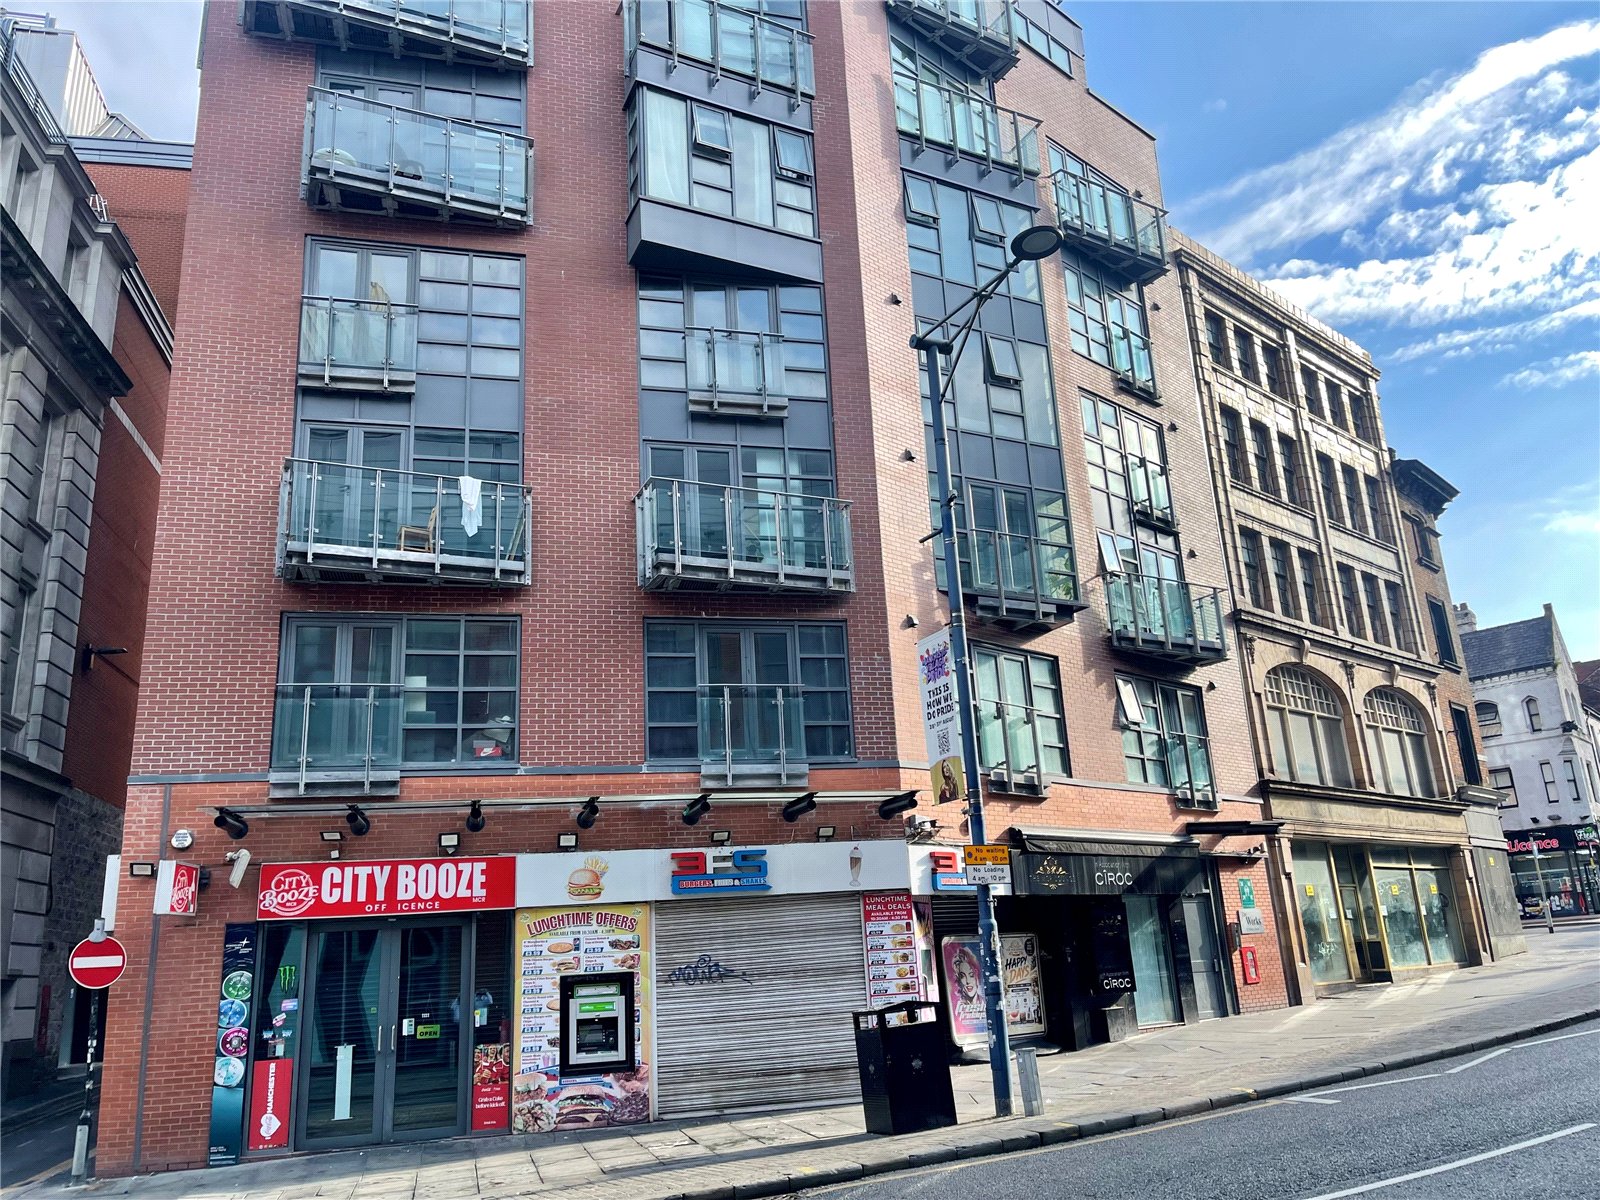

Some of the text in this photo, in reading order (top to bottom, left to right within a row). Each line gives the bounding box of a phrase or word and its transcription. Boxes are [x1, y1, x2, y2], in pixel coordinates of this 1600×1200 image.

[927, 682, 950, 699] THIS IS
[926, 692, 953, 710] HOW WE
[927, 703, 954, 720] DO PRIDE
[1507, 838, 1559, 853] Licence
[671, 849, 768, 876] 3FS
[271, 875, 311, 893] CITY
[321, 862, 486, 904] CITY BOOZE
[741, 877, 767, 885] SHAKES
[260, 885, 319, 910] BOOZE
[866, 895, 908, 903] LUNCHTIME
[365, 901, 441, 912] OFF ICENCE
[526, 911, 639, 936] LUNCHTIME OFFERS
[1004, 956, 1028, 970] HAPPY
[1009, 966, 1030, 982] DAYS
[266, 1062, 276, 1114] MANCHESTER
